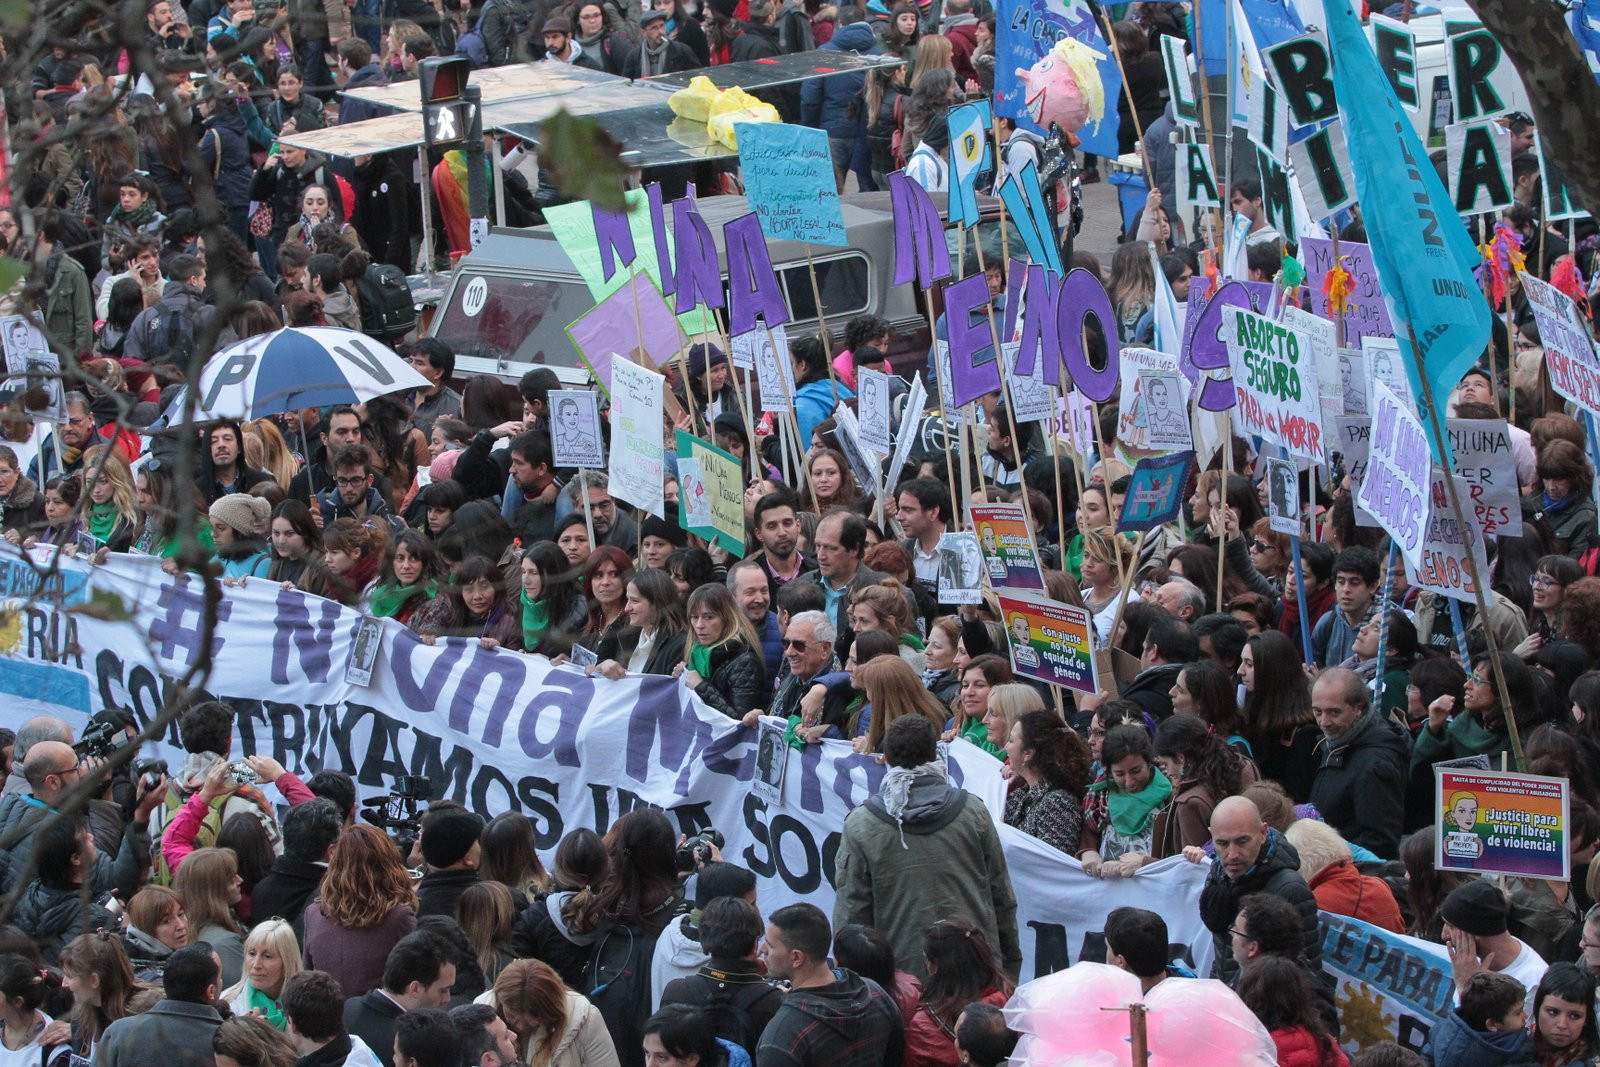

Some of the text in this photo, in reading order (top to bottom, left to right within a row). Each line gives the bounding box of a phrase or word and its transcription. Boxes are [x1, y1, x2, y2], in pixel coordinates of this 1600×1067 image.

[467, 285, 484, 308] 110
[1236, 311, 1299, 365] ABORTO
[1243, 350, 1302, 402] SEGURO
[1237, 387, 1264, 432] PARA
[1277, 407, 1324, 459] MORIR
[1472, 430, 1511, 454] UNA
[1361, 455, 1422, 551] MENOS
[1041, 625, 1082, 645] Con ajuste
[1050, 641, 1077, 658] no hay
[1043, 650, 1074, 667] equidad
[1076, 660, 1086, 670] de
[1053, 665, 1081, 681] género
[1485, 808, 1558, 826] ¡Justicia para
[1493, 823, 1550, 838] vivir libres
[1487, 835, 1556, 852] de violencia!
